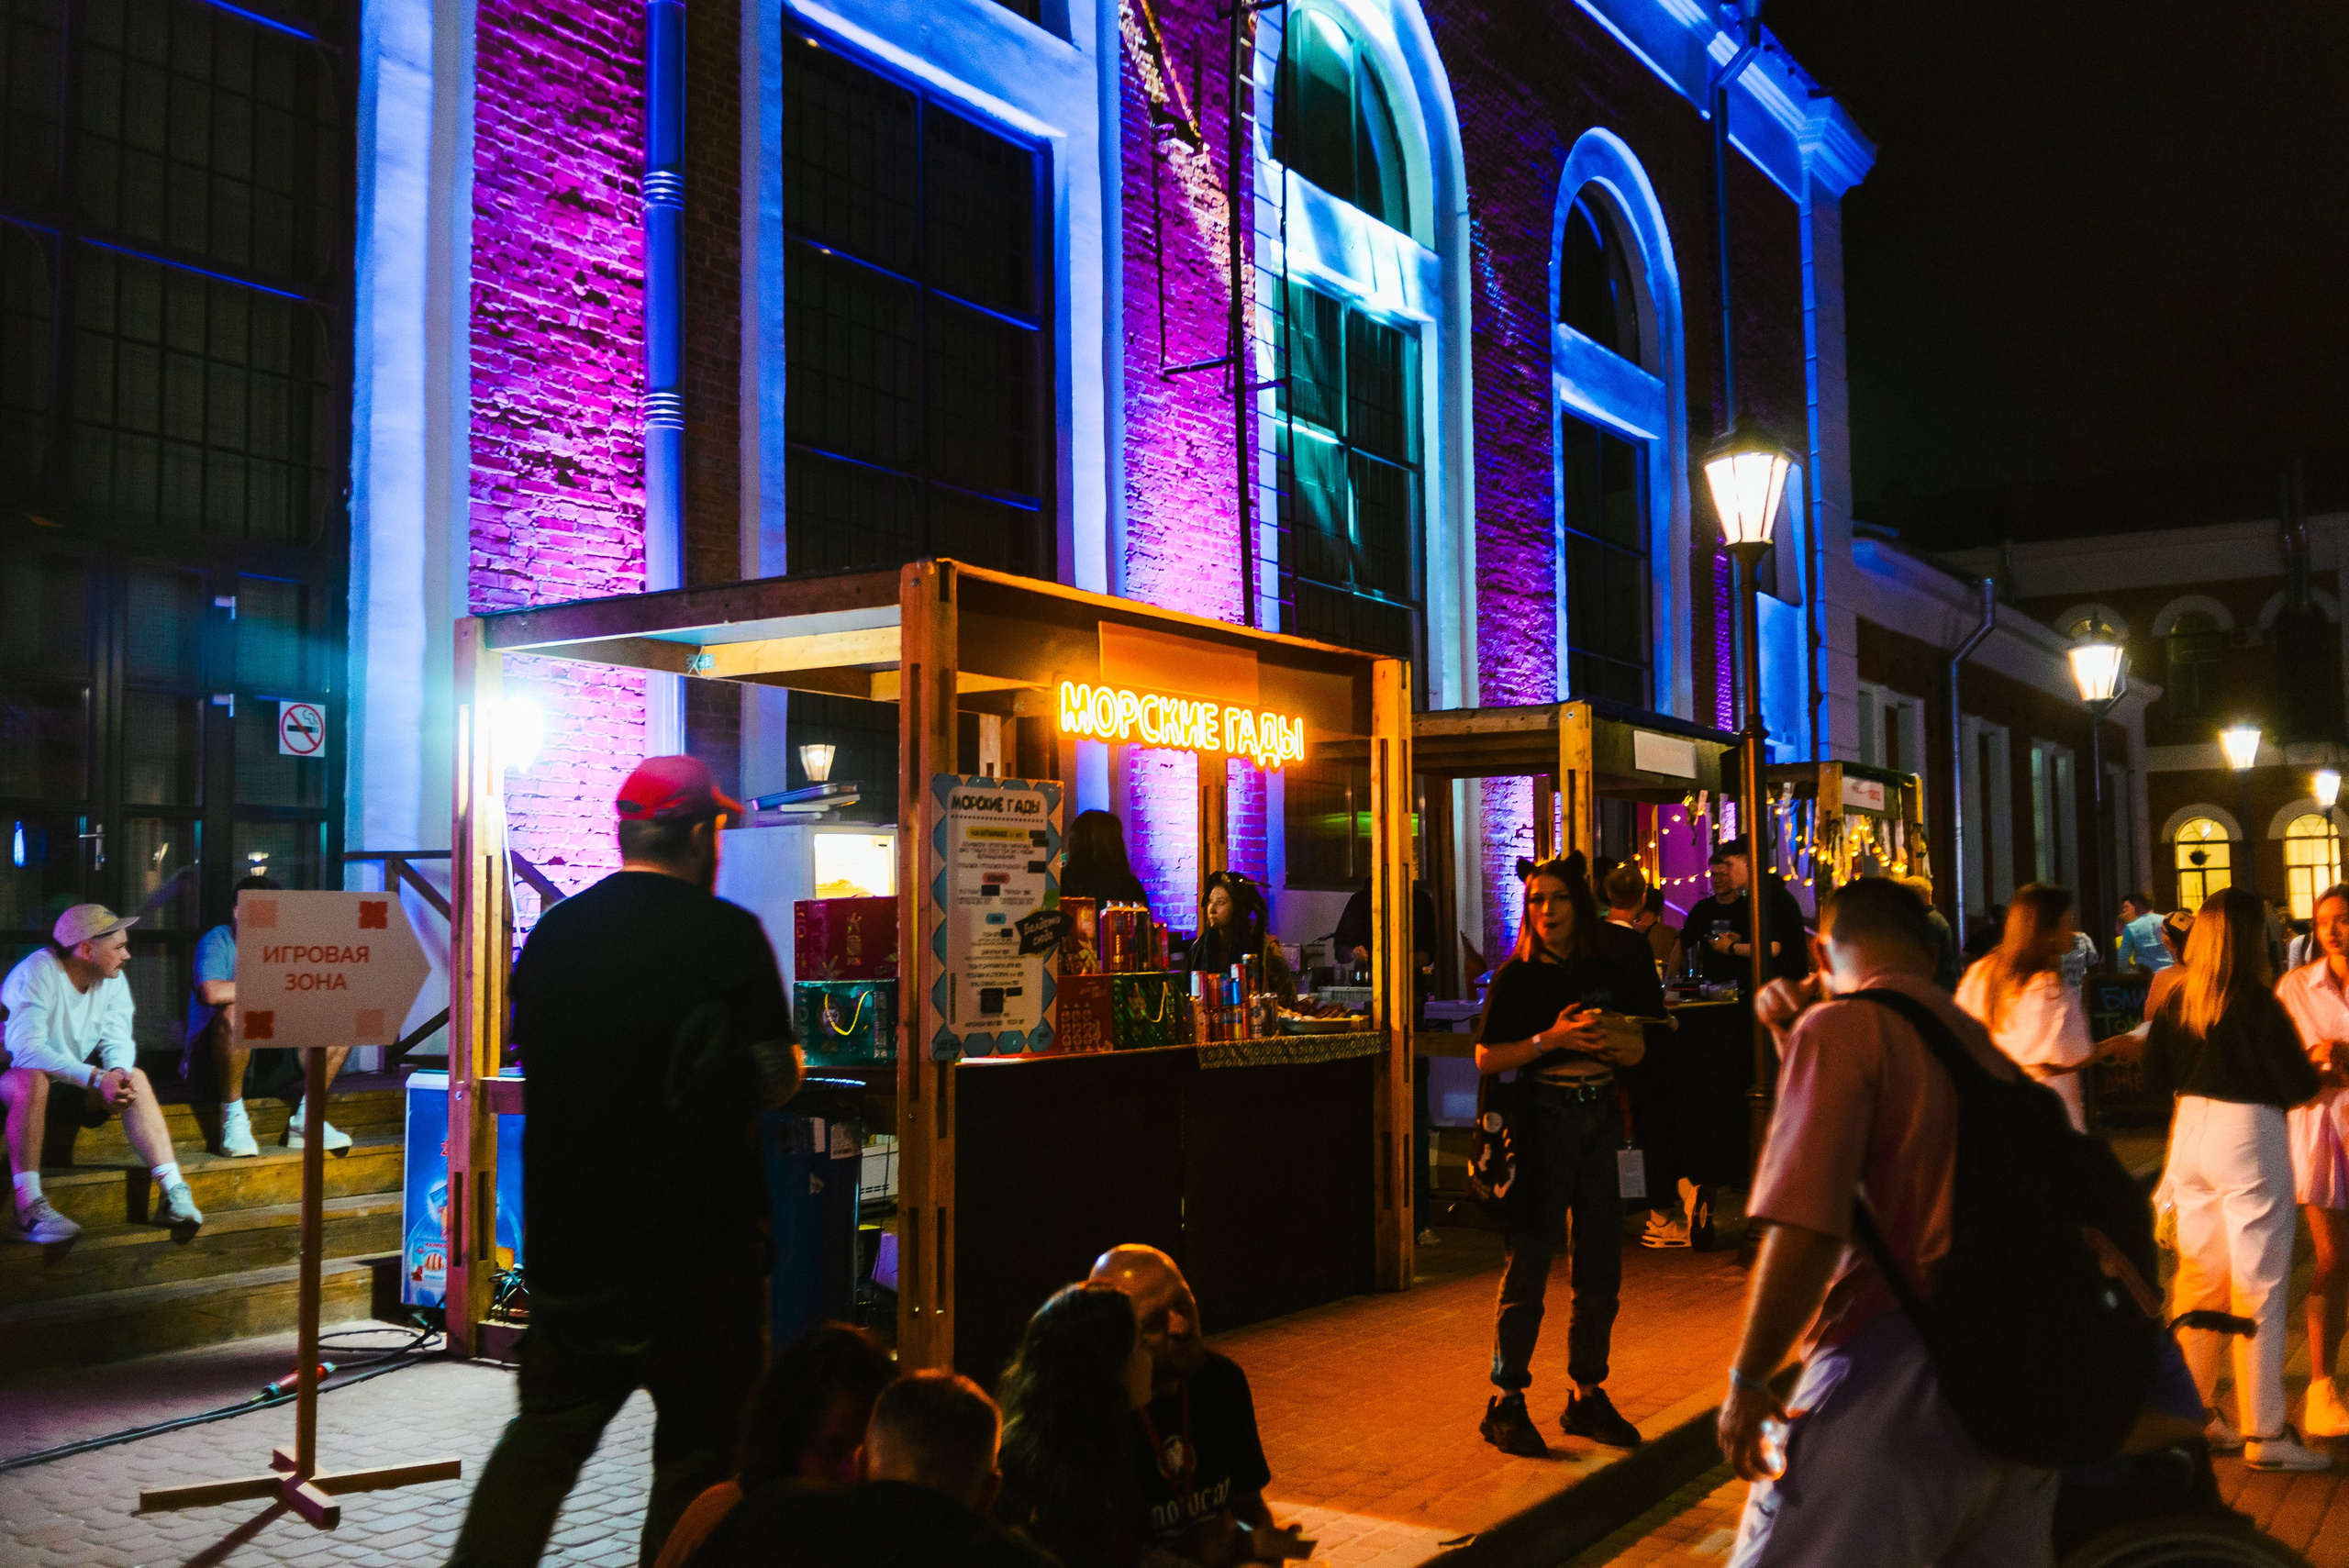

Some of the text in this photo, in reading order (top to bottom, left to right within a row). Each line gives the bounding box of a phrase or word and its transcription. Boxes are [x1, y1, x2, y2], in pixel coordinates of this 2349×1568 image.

[1060, 681, 1305, 768] МОРСКИЕ ГАДЫ
[951, 795, 1041, 815] МОРСКИЕ ГАДЫ
[262, 945, 370, 963] ИГРОВАЯ
[284, 973, 348, 991] ЗОНА
